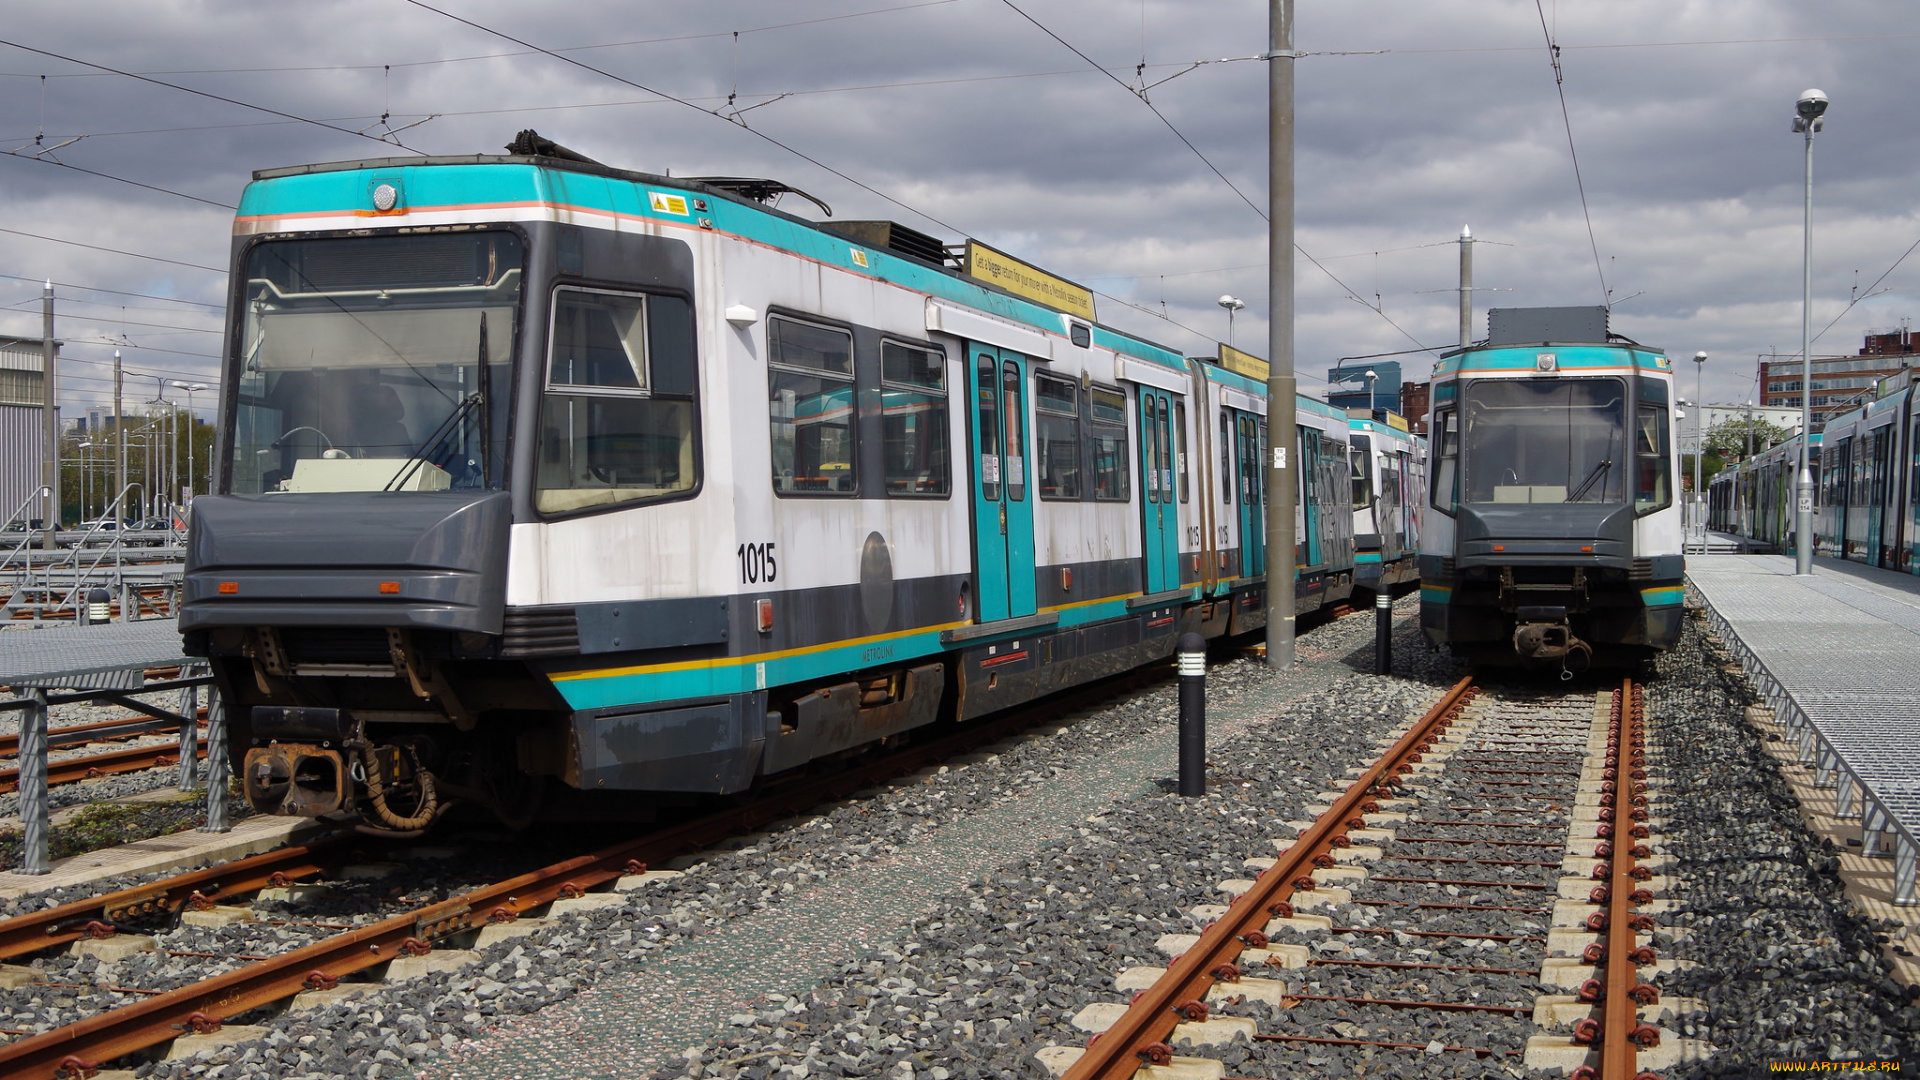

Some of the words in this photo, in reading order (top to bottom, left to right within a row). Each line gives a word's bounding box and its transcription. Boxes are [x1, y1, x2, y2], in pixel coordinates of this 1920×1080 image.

[975, 252, 985, 269] Get
[988, 257, 1002, 278] bigger
[1002, 265, 1014, 281] return
[1020, 273, 1029, 288] your
[1187, 525, 1200, 547] 1015
[1218, 525, 1229, 545] 1015
[737, 542, 777, 584] 1015
[862, 644, 894, 662] METROLINK
